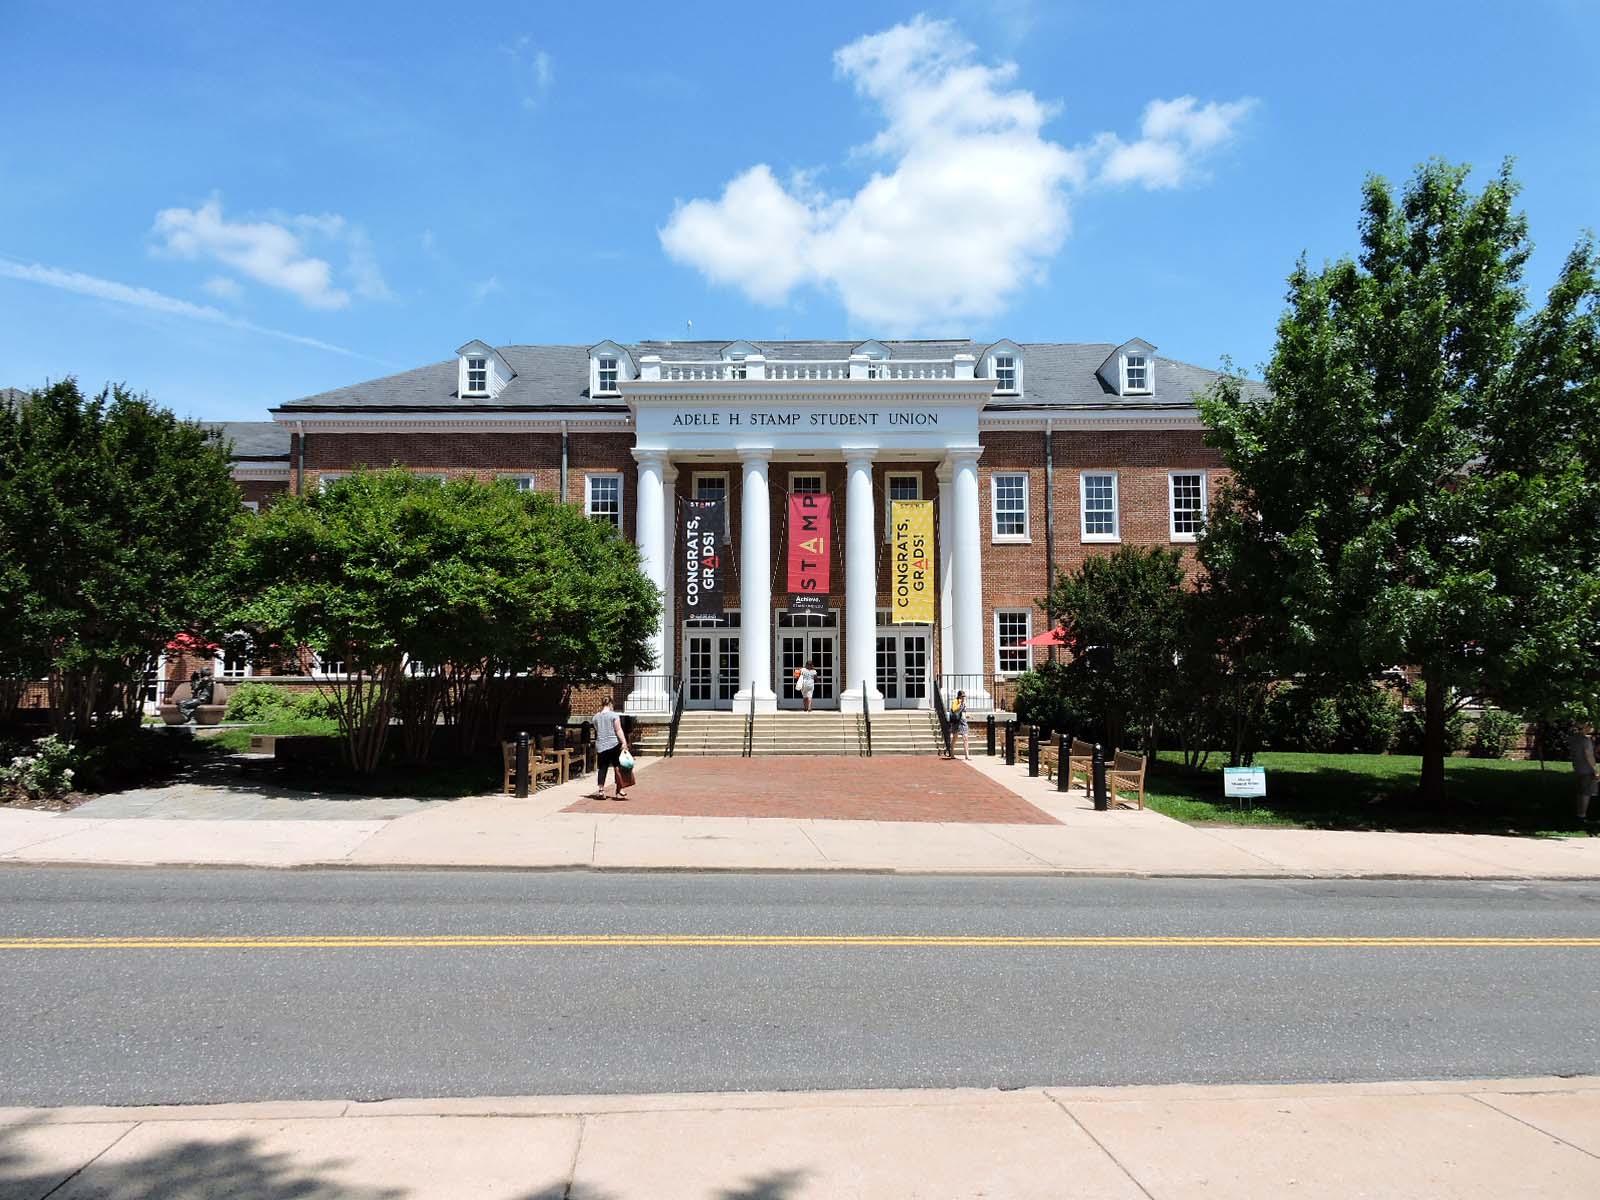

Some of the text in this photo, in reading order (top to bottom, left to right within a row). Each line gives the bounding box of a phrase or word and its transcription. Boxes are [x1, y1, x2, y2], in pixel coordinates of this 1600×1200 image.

[673, 413, 720, 425] ADELE
[750, 413, 801, 425] STAMP
[809, 413, 879, 425] STUDENT
[888, 413, 938, 425] UNION
[690, 501, 717, 509] STAMP
[687, 516, 701, 606] CONGRATS,
[702, 532, 720, 590] GRADS!
[800, 495, 824, 590] STAMP
[897, 519, 910, 608] CONGRATS,
[912, 535, 928, 592] GRADS!
